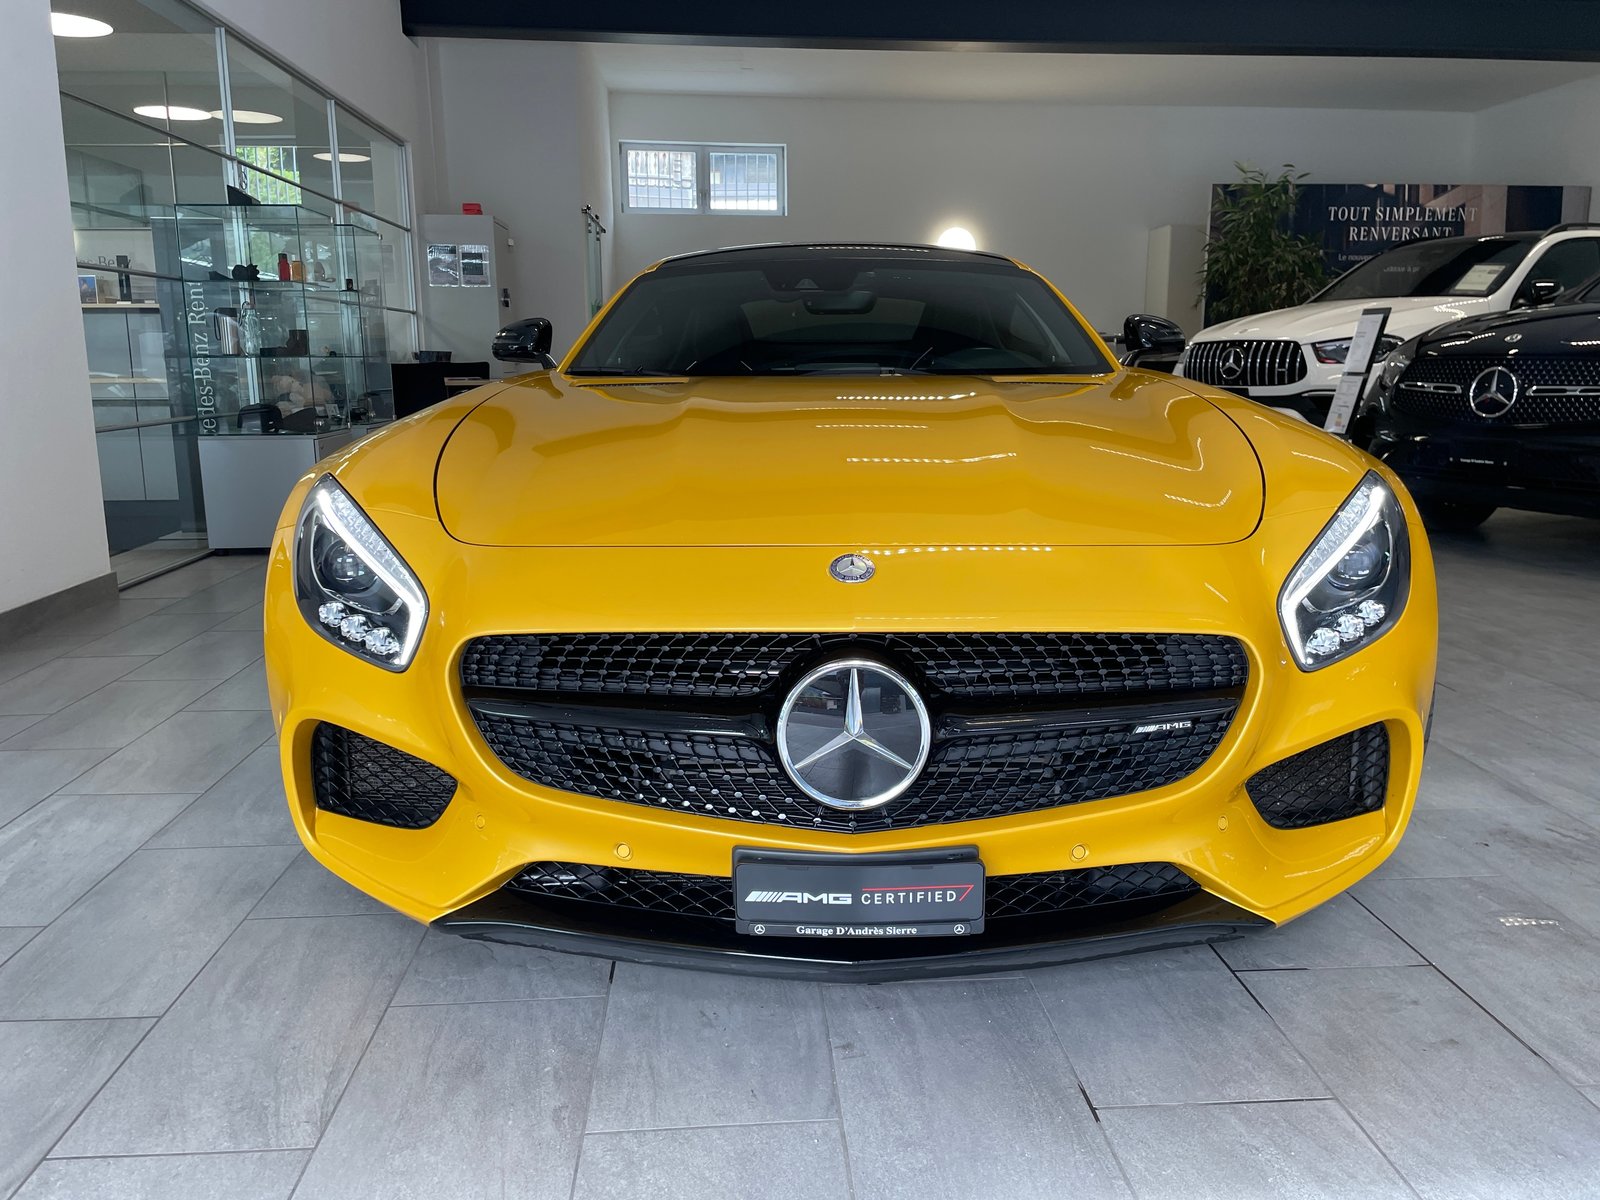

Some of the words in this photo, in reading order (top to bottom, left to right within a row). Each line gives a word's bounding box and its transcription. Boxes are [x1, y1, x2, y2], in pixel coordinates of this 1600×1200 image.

[1328, 206, 1370, 221] TOUT
[1375, 206, 1478, 222] SIMPLEMENT
[1348, 226, 1452, 242] RENVERSANT
[777, 891, 852, 905] AMG
[861, 890, 957, 905] CERTIFIED
[796, 925, 834, 936] Garage
[836, 925, 884, 936] D'Andrès
[886, 926, 918, 935] Sierre
